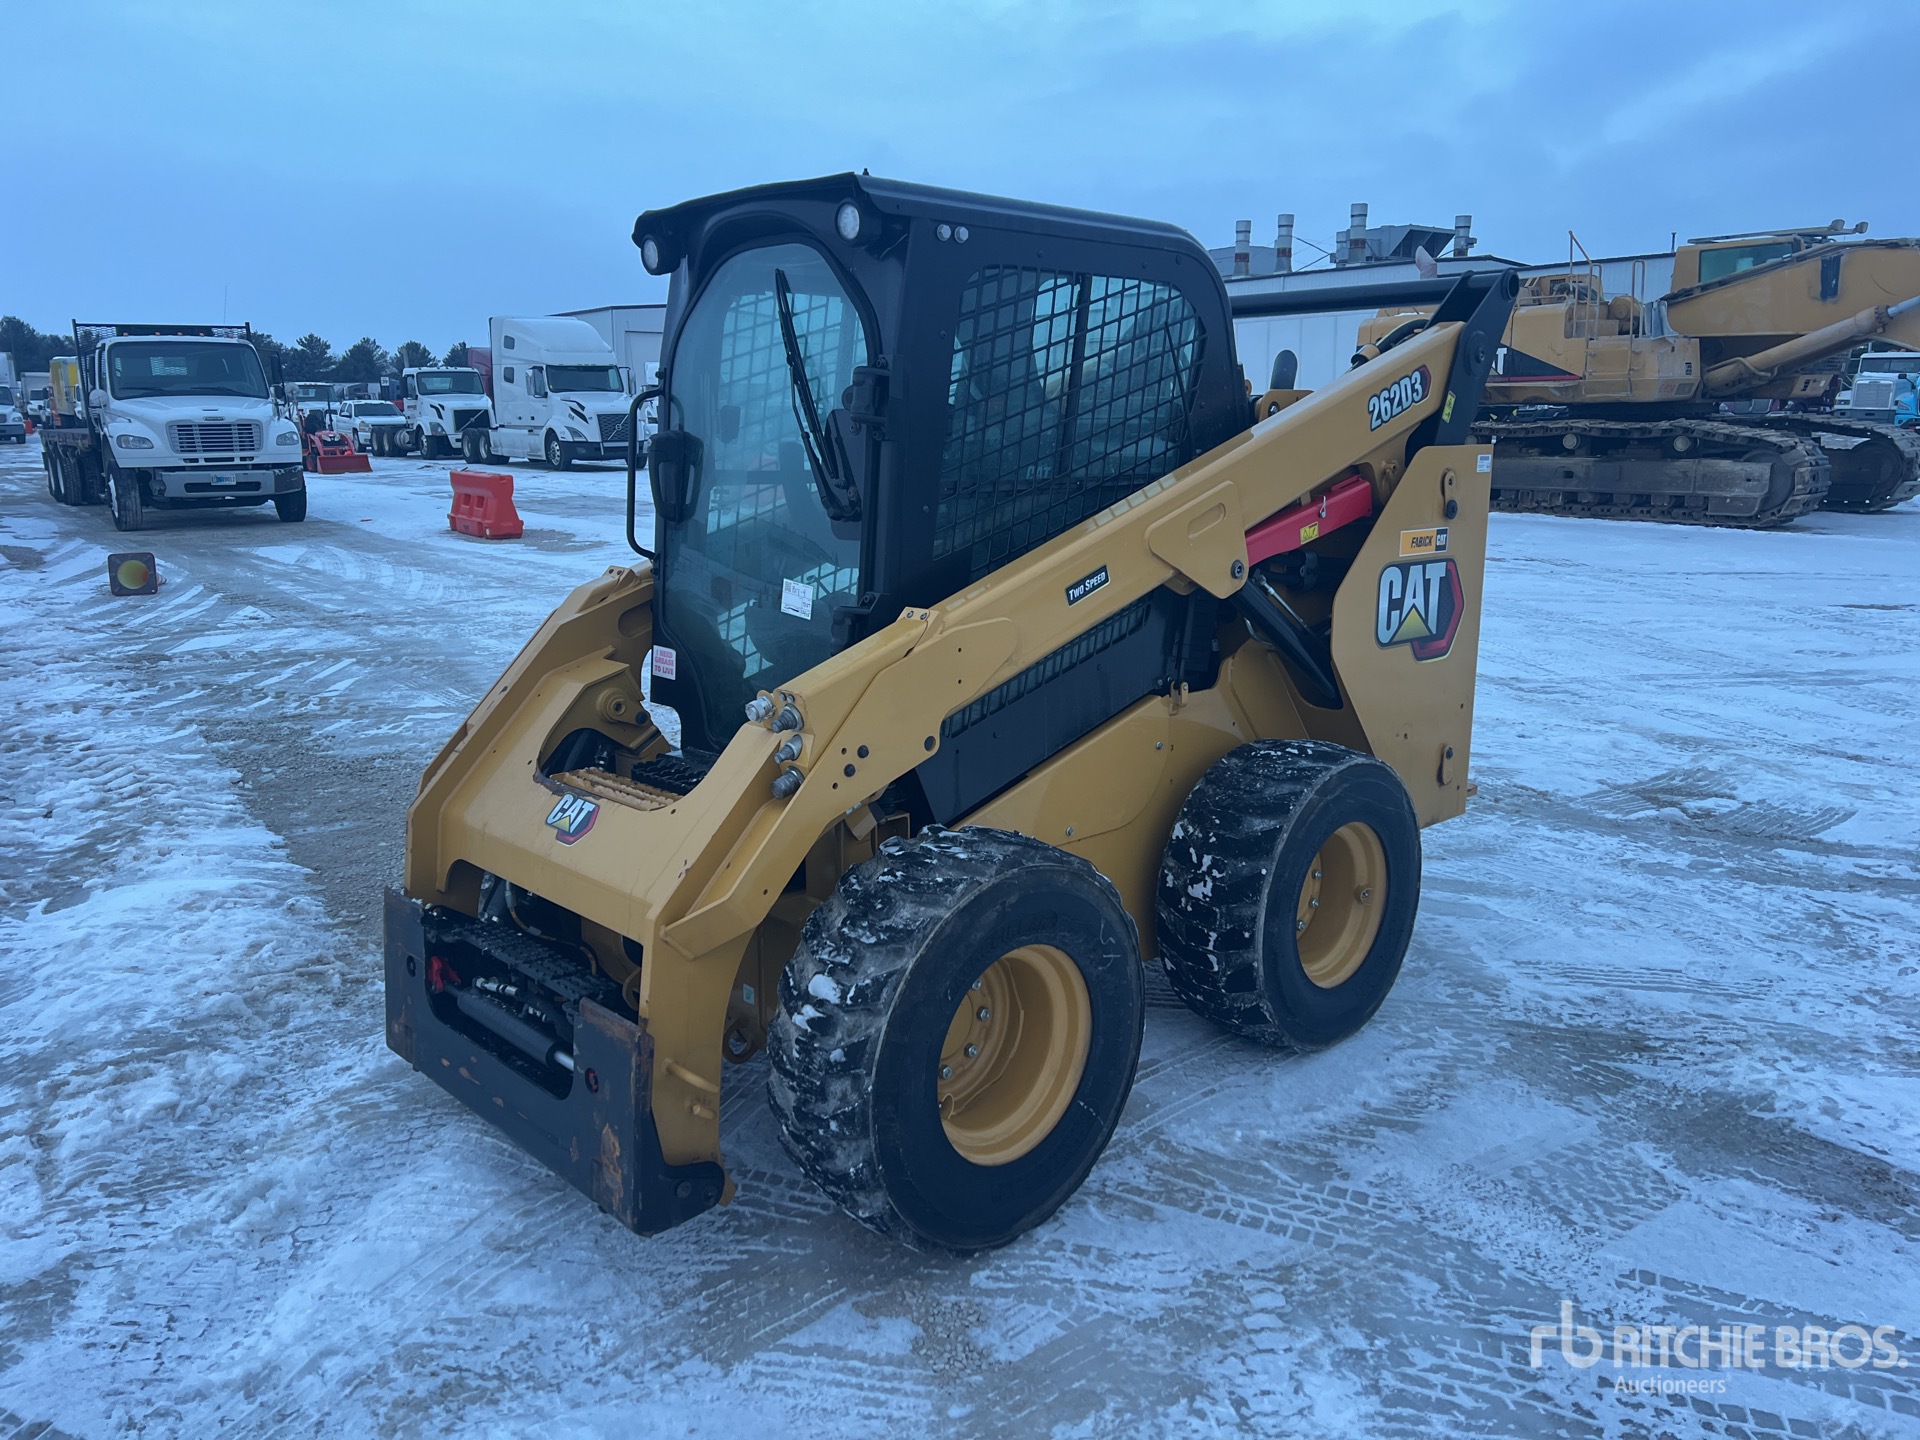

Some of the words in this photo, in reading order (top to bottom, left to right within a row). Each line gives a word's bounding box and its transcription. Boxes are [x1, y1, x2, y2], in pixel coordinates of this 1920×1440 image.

[1368, 370, 1423, 430] 262D3
[1410, 535, 1434, 548] FABICK
[1436, 533, 1447, 546] CAT
[1377, 561, 1447, 644] CAT
[546, 793, 596, 834] CAT
